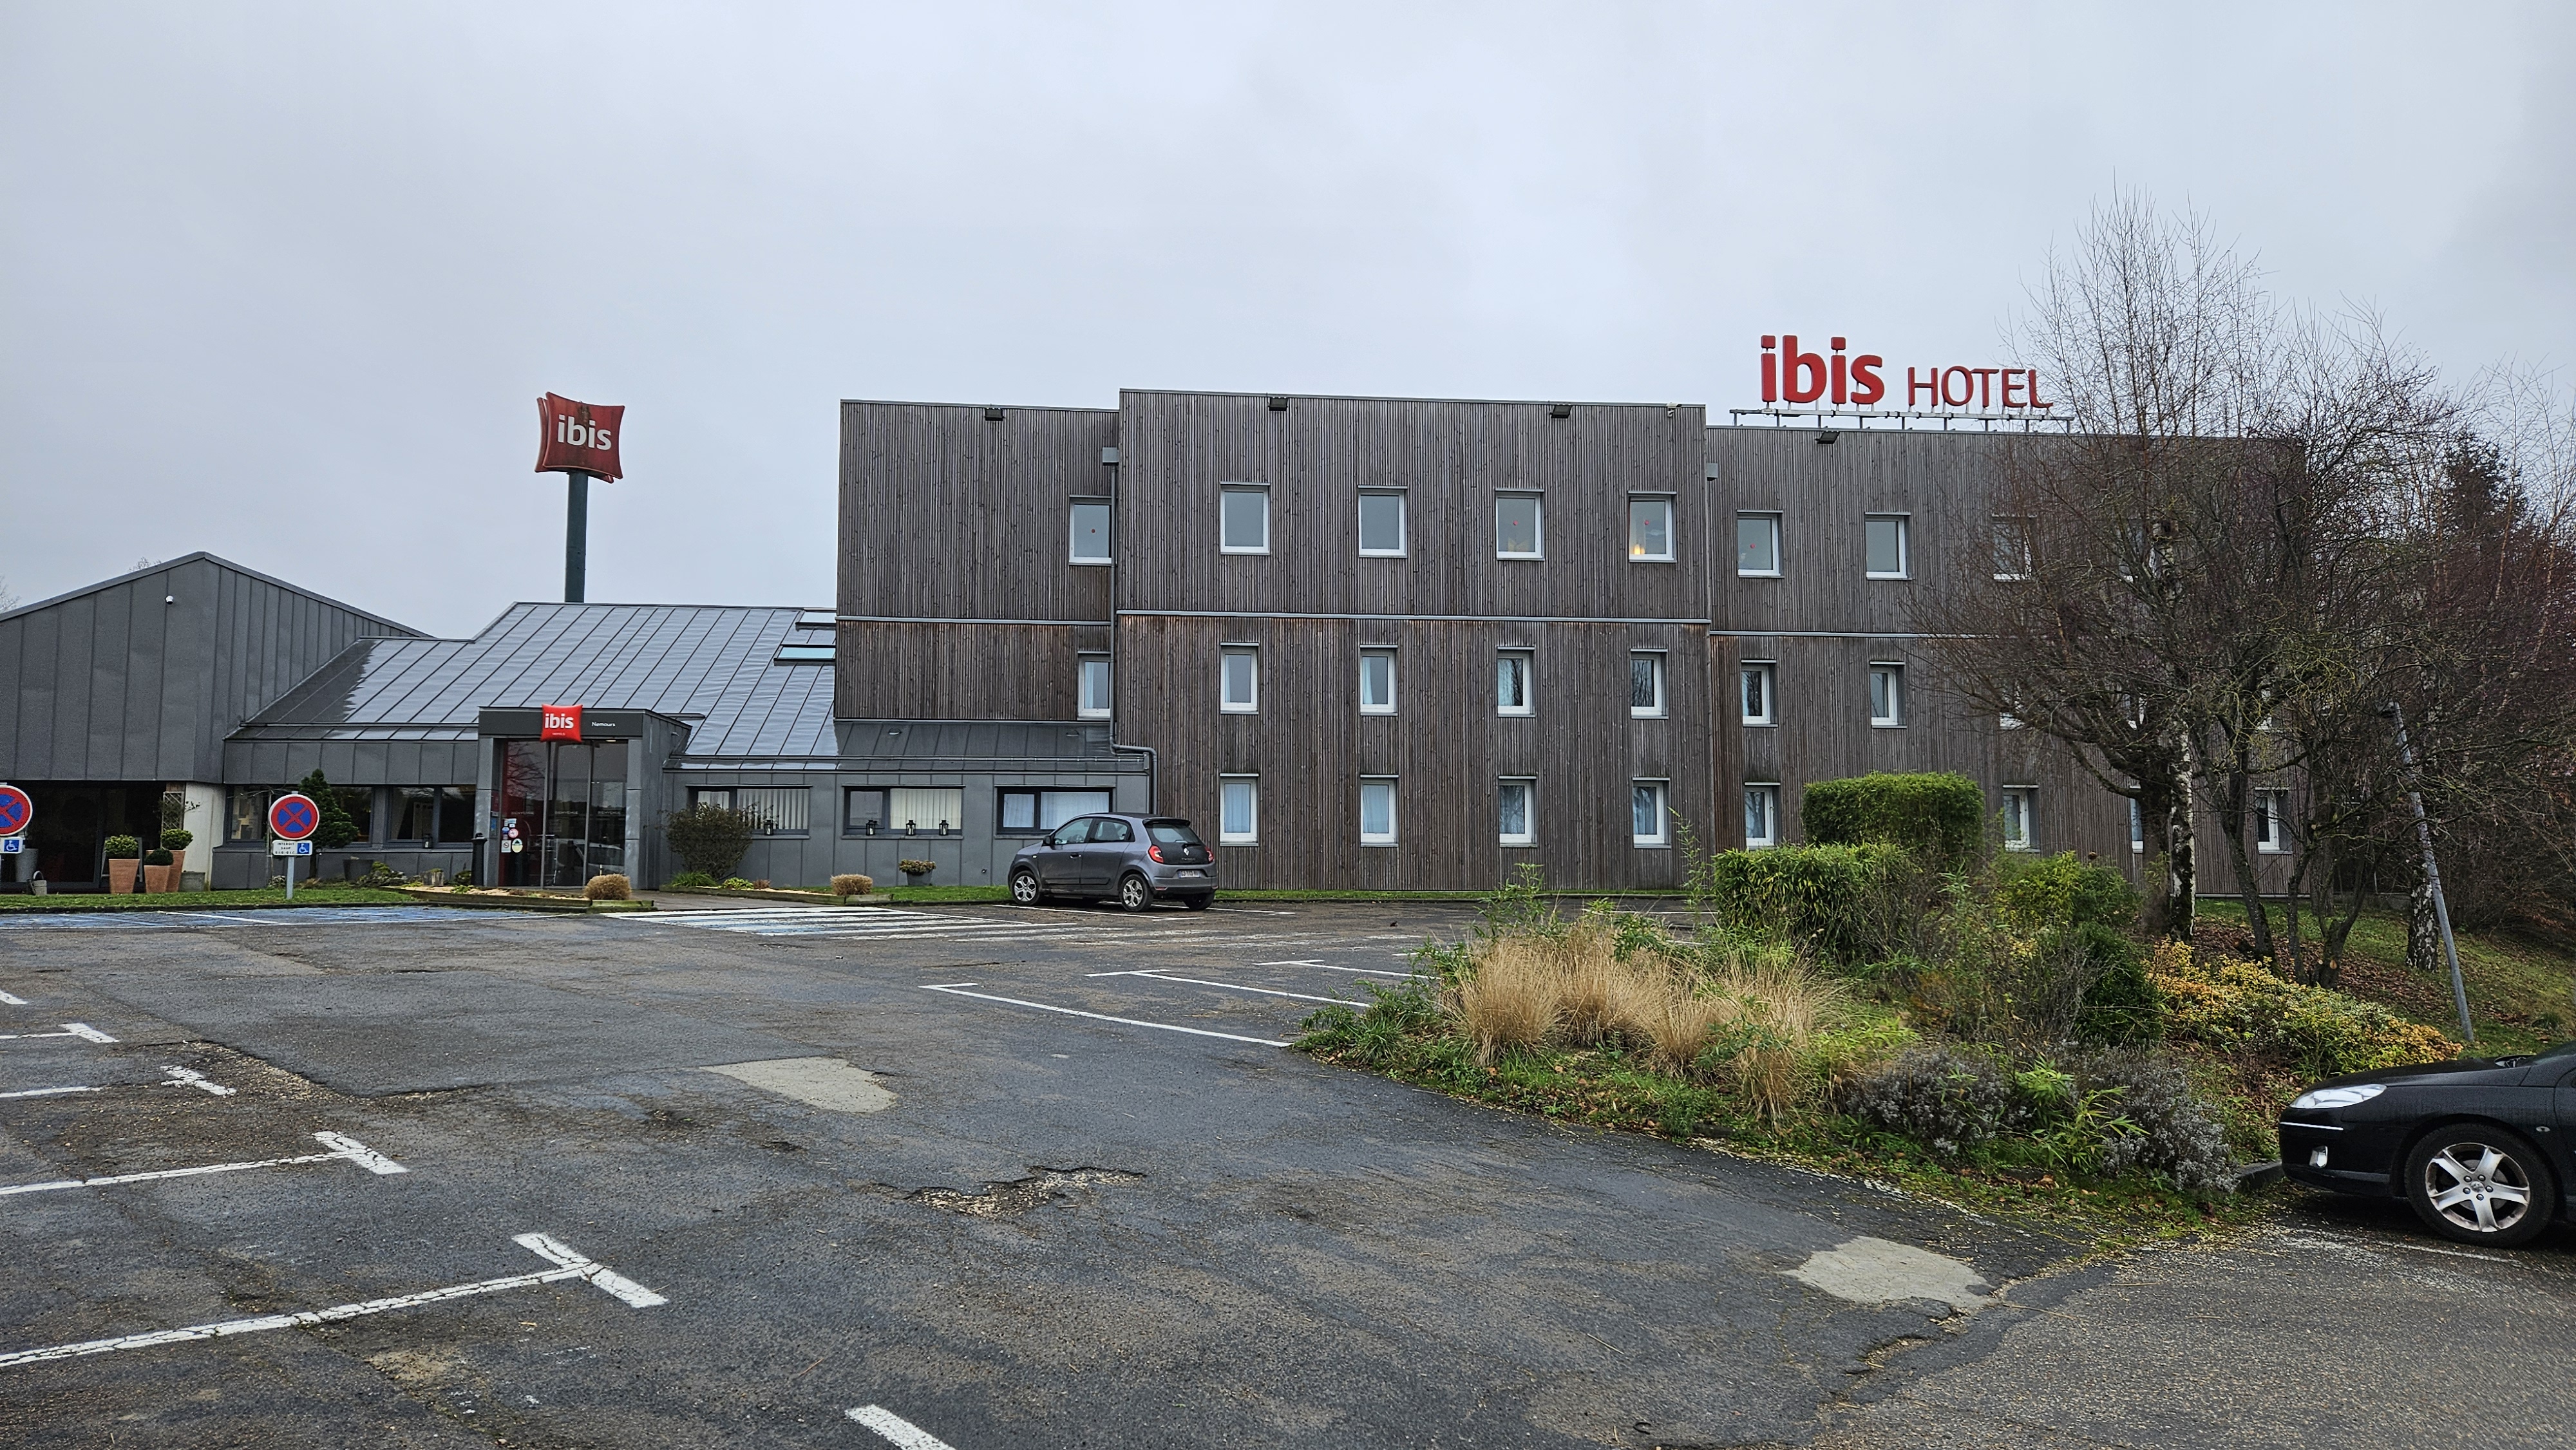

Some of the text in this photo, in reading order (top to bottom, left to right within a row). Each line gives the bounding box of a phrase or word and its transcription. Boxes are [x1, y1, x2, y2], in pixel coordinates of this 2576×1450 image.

[1761, 335, 2054, 409] ibis HOTEL
[557, 414, 611, 450] ibis
[544, 713, 574, 728] ibis
